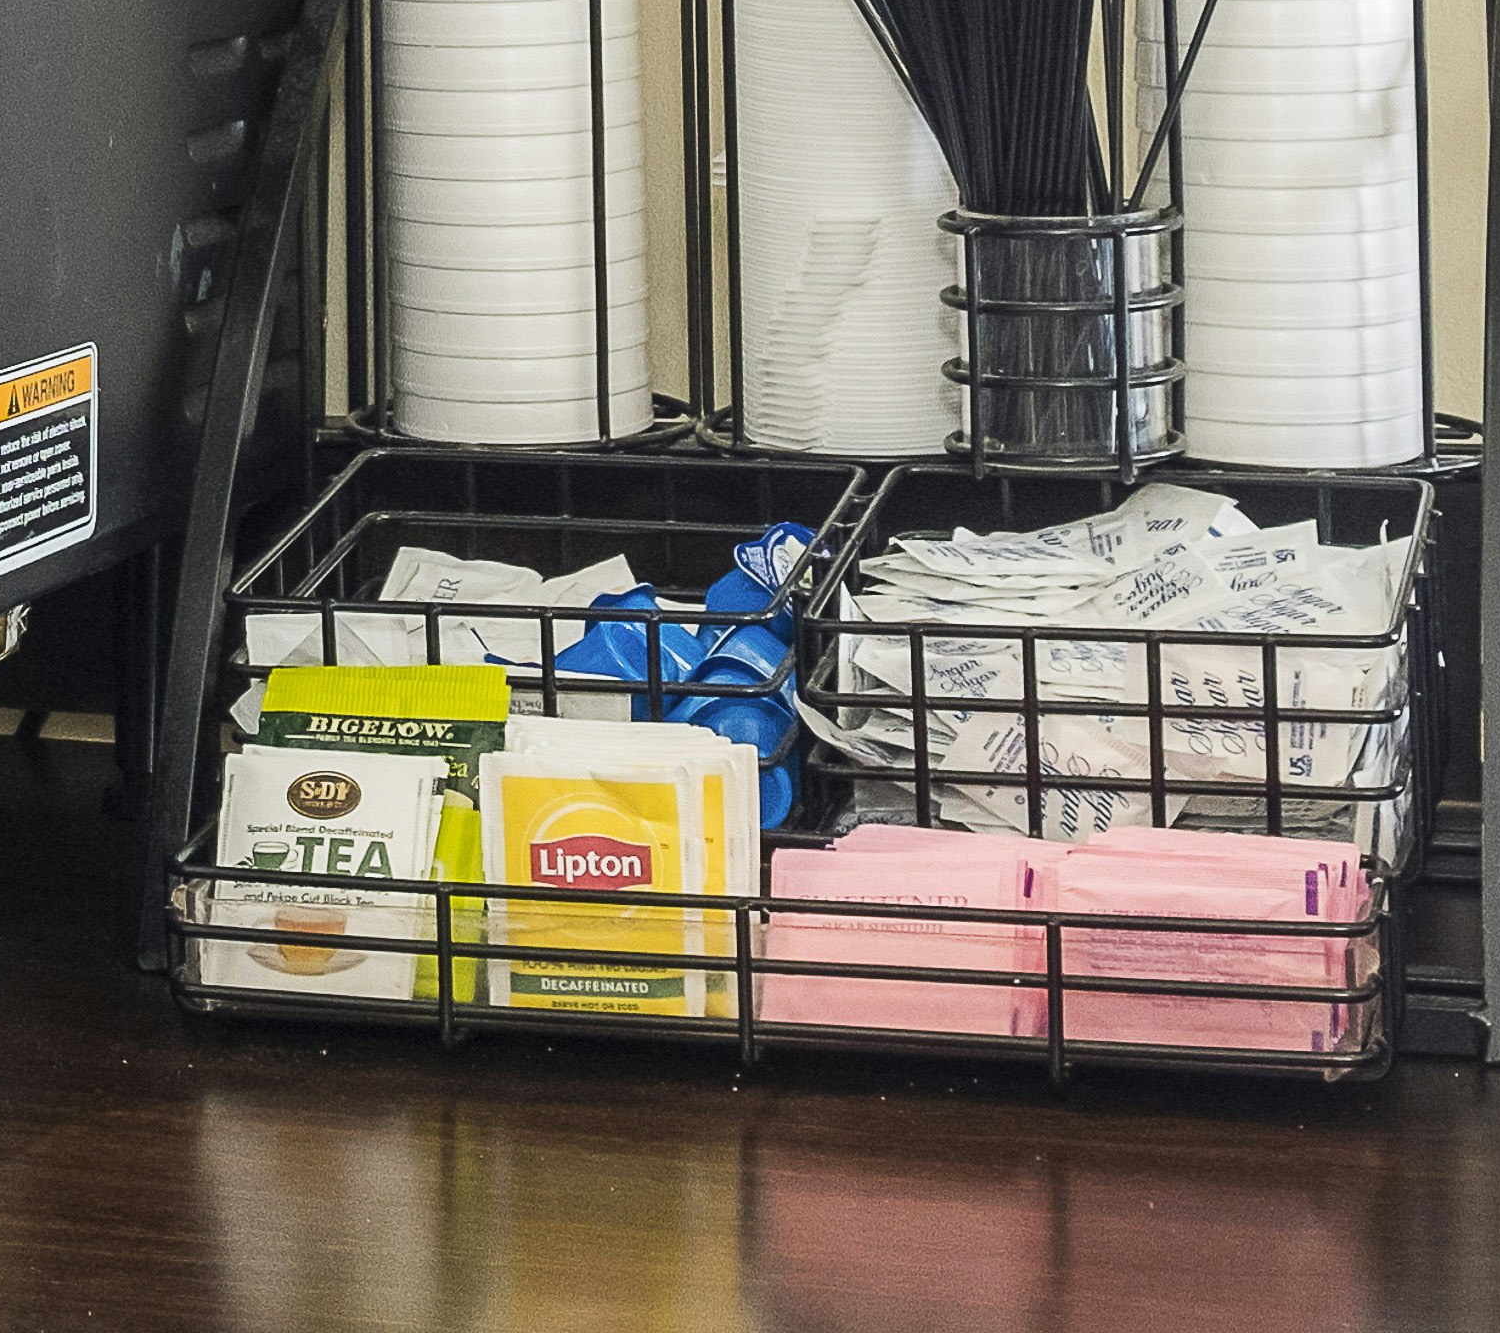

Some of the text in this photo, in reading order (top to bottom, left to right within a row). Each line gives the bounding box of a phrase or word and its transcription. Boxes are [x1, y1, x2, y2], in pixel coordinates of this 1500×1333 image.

[22, 370, 75, 409] WARNING
[306, 716, 453, 739] BIGELOW
[296, 836, 394, 879] TEA
[539, 847, 642, 883] Lipton
[540, 978, 650, 994] DECAFFEINATED
